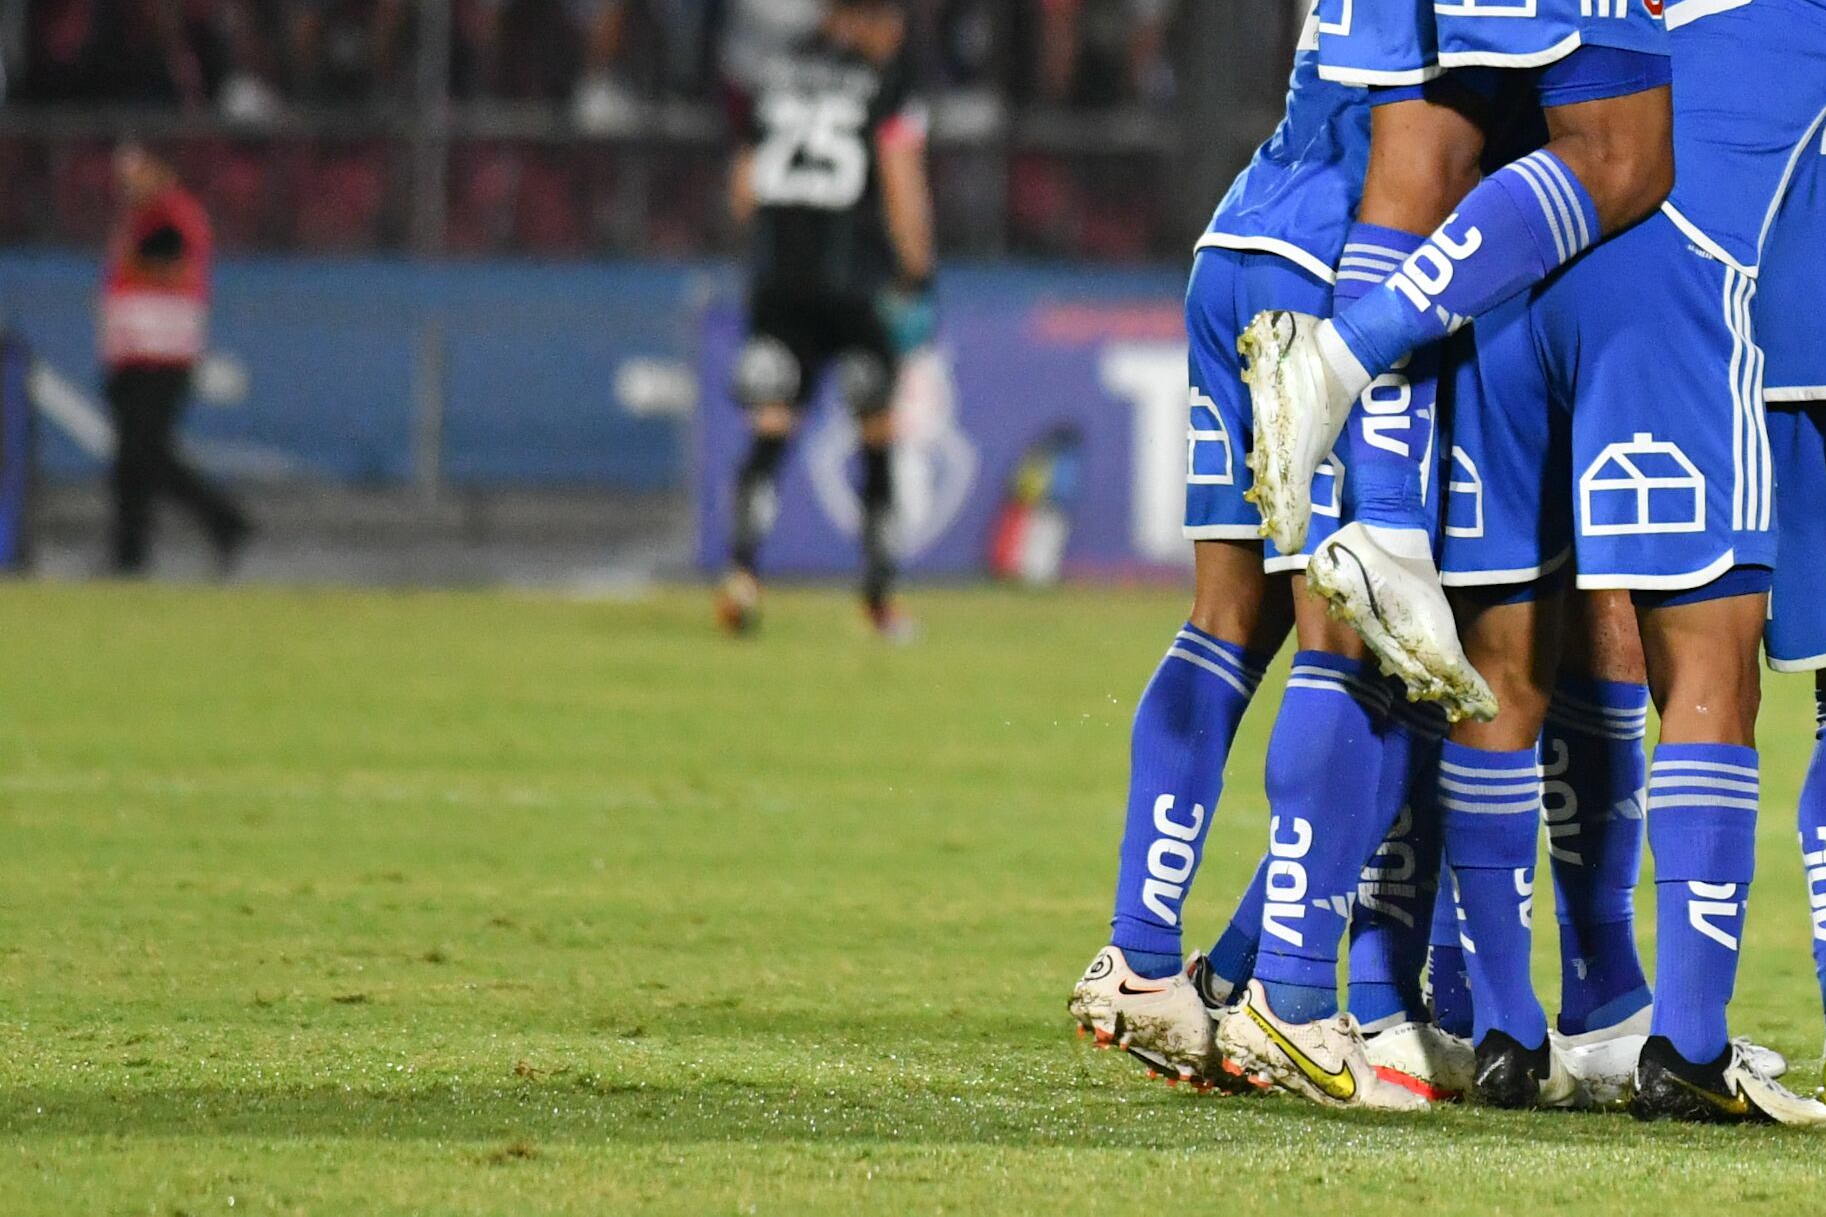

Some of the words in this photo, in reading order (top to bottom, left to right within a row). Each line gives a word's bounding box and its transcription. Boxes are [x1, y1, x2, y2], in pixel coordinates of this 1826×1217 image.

[752, 91, 868, 208] 25
[1142, 794, 1205, 926] AOC
[1263, 816, 1313, 947] AOC
